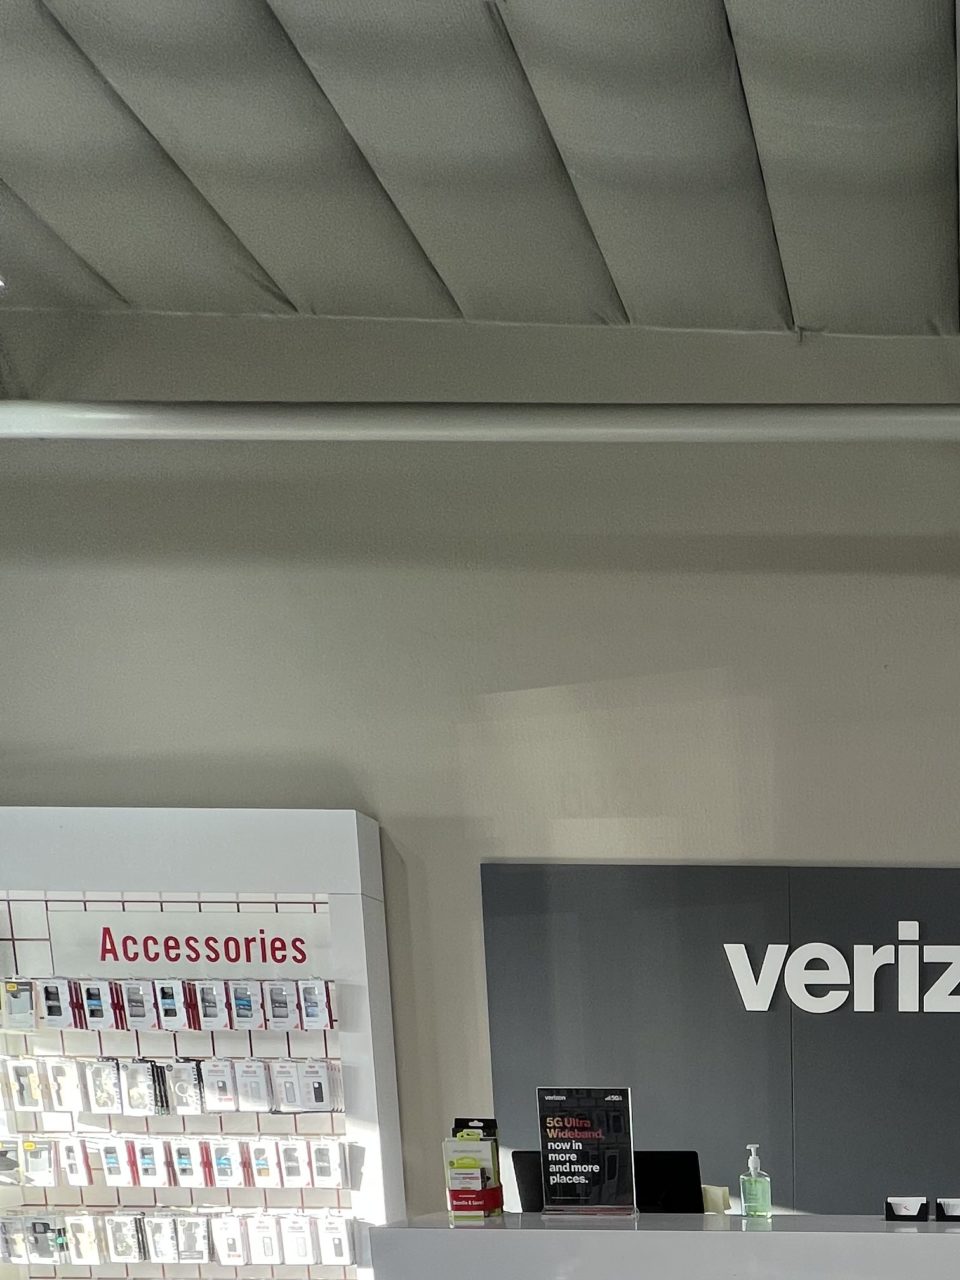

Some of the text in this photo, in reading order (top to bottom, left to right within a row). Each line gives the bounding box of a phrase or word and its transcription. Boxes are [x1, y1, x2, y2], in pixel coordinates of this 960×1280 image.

[100, 927, 308, 964] Accessories
[546, 1117, 591, 1128] 5G Ultra
[547, 1140, 583, 1150] now in
[548, 1153, 577, 1161] more
[549, 1162, 600, 1172] and more
[549, 1173, 589, 1185] places.
